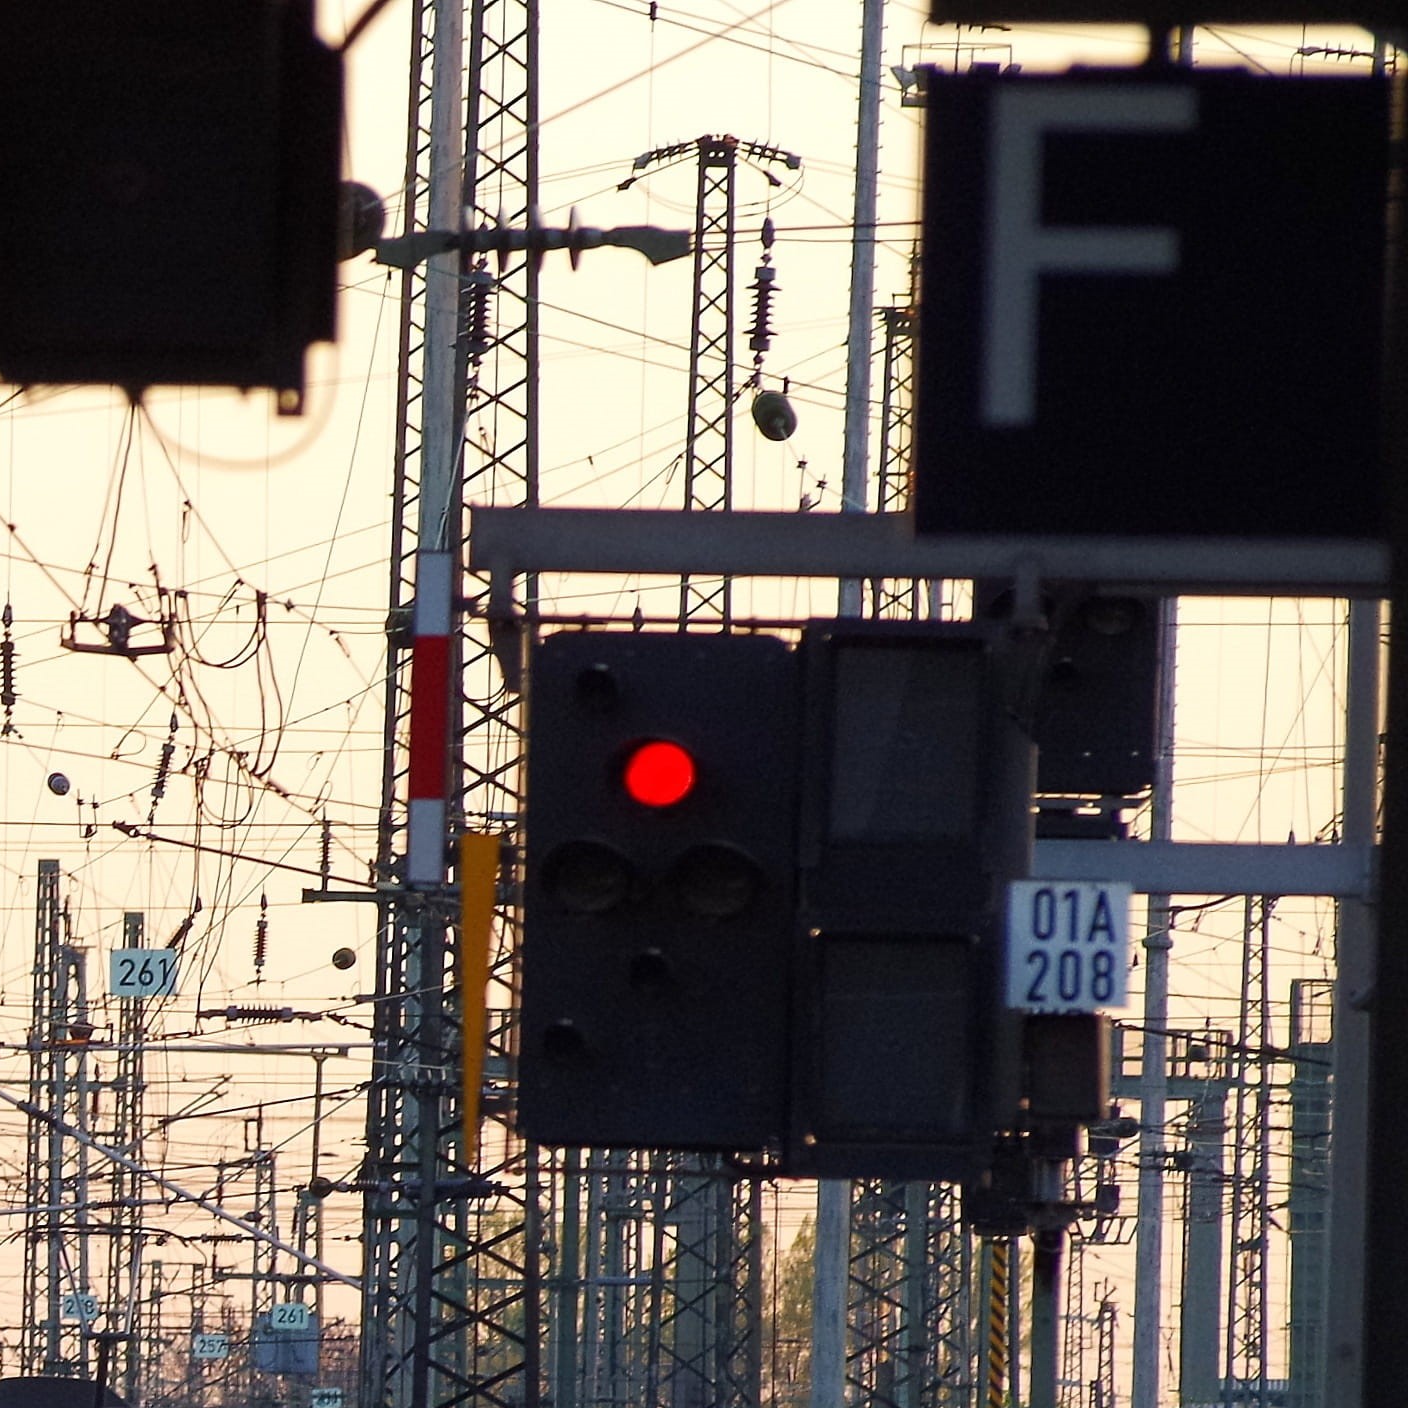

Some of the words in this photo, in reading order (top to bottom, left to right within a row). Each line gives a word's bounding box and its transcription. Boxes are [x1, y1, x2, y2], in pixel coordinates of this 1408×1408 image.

[983, 84, 1199, 428] F
[1034, 888, 1116, 942] 01A
[119, 958, 167, 987] 261
[1026, 950, 1115, 1002] 208
[278, 1308, 305, 1324] 261
